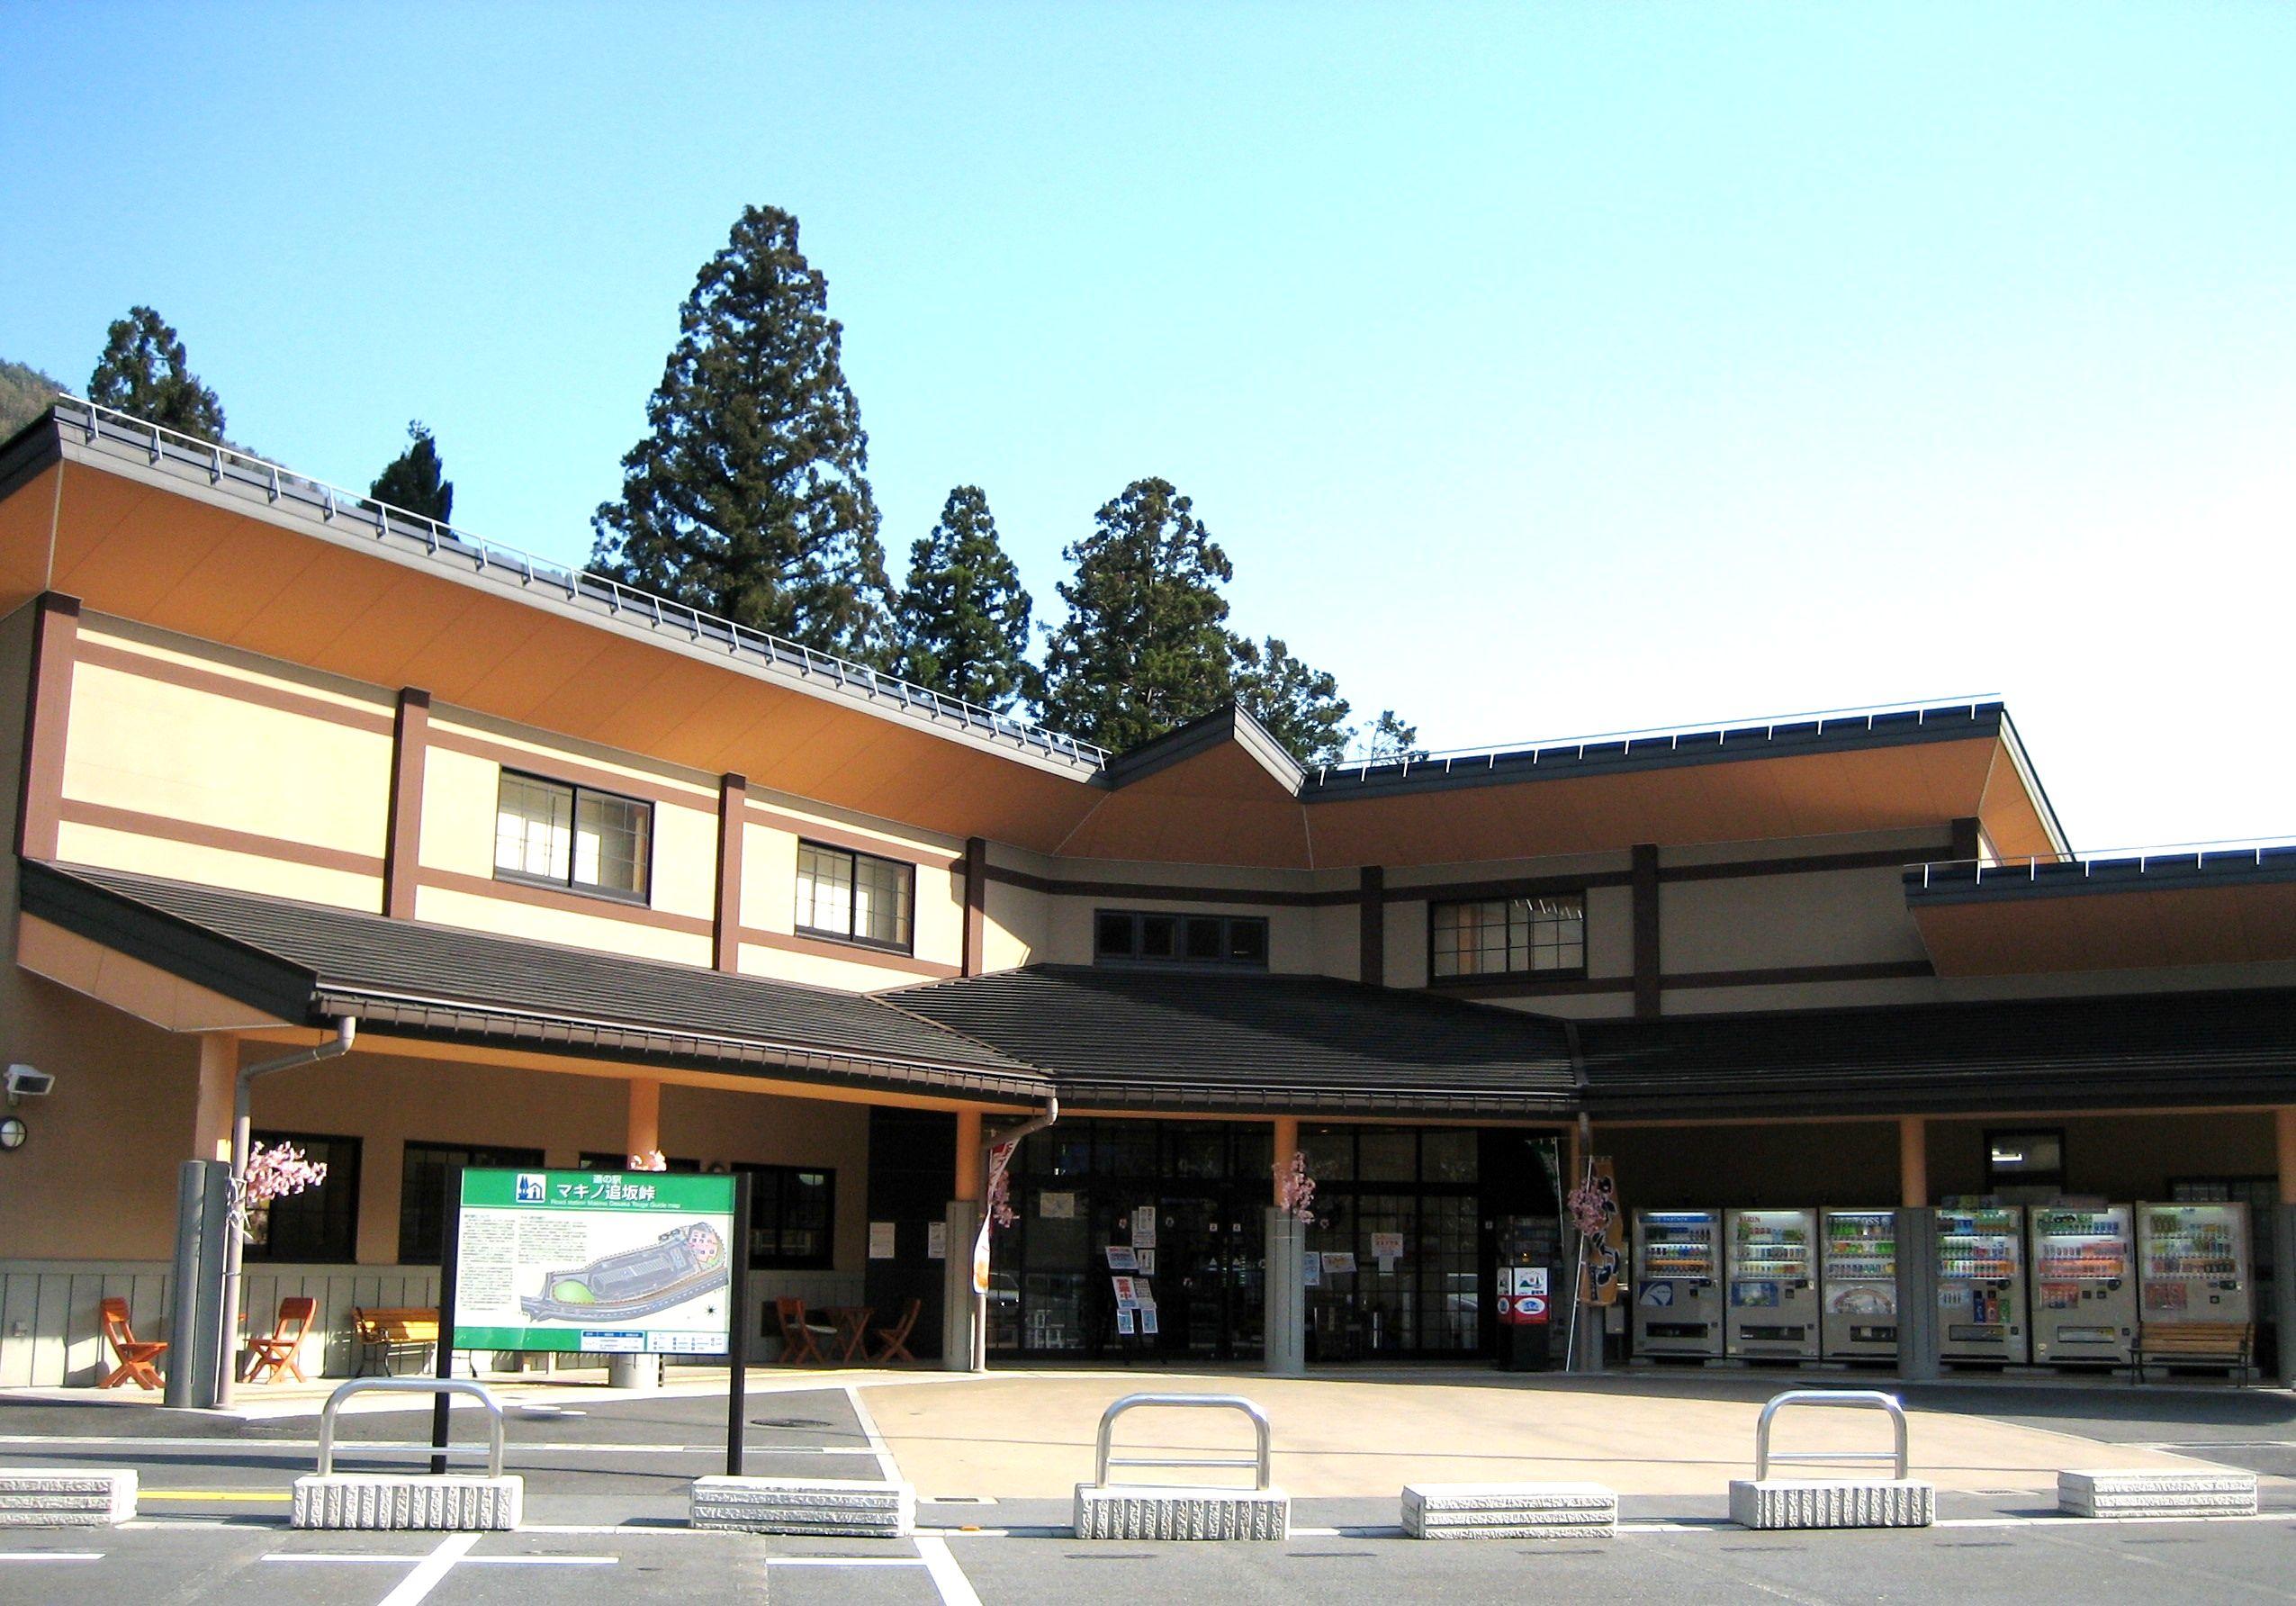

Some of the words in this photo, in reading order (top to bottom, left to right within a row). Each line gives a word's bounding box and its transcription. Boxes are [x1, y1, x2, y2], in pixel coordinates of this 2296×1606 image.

[592, 1174, 622, 1184] 道の駅
[556, 1183, 656, 1201] マキノ追坂峠
